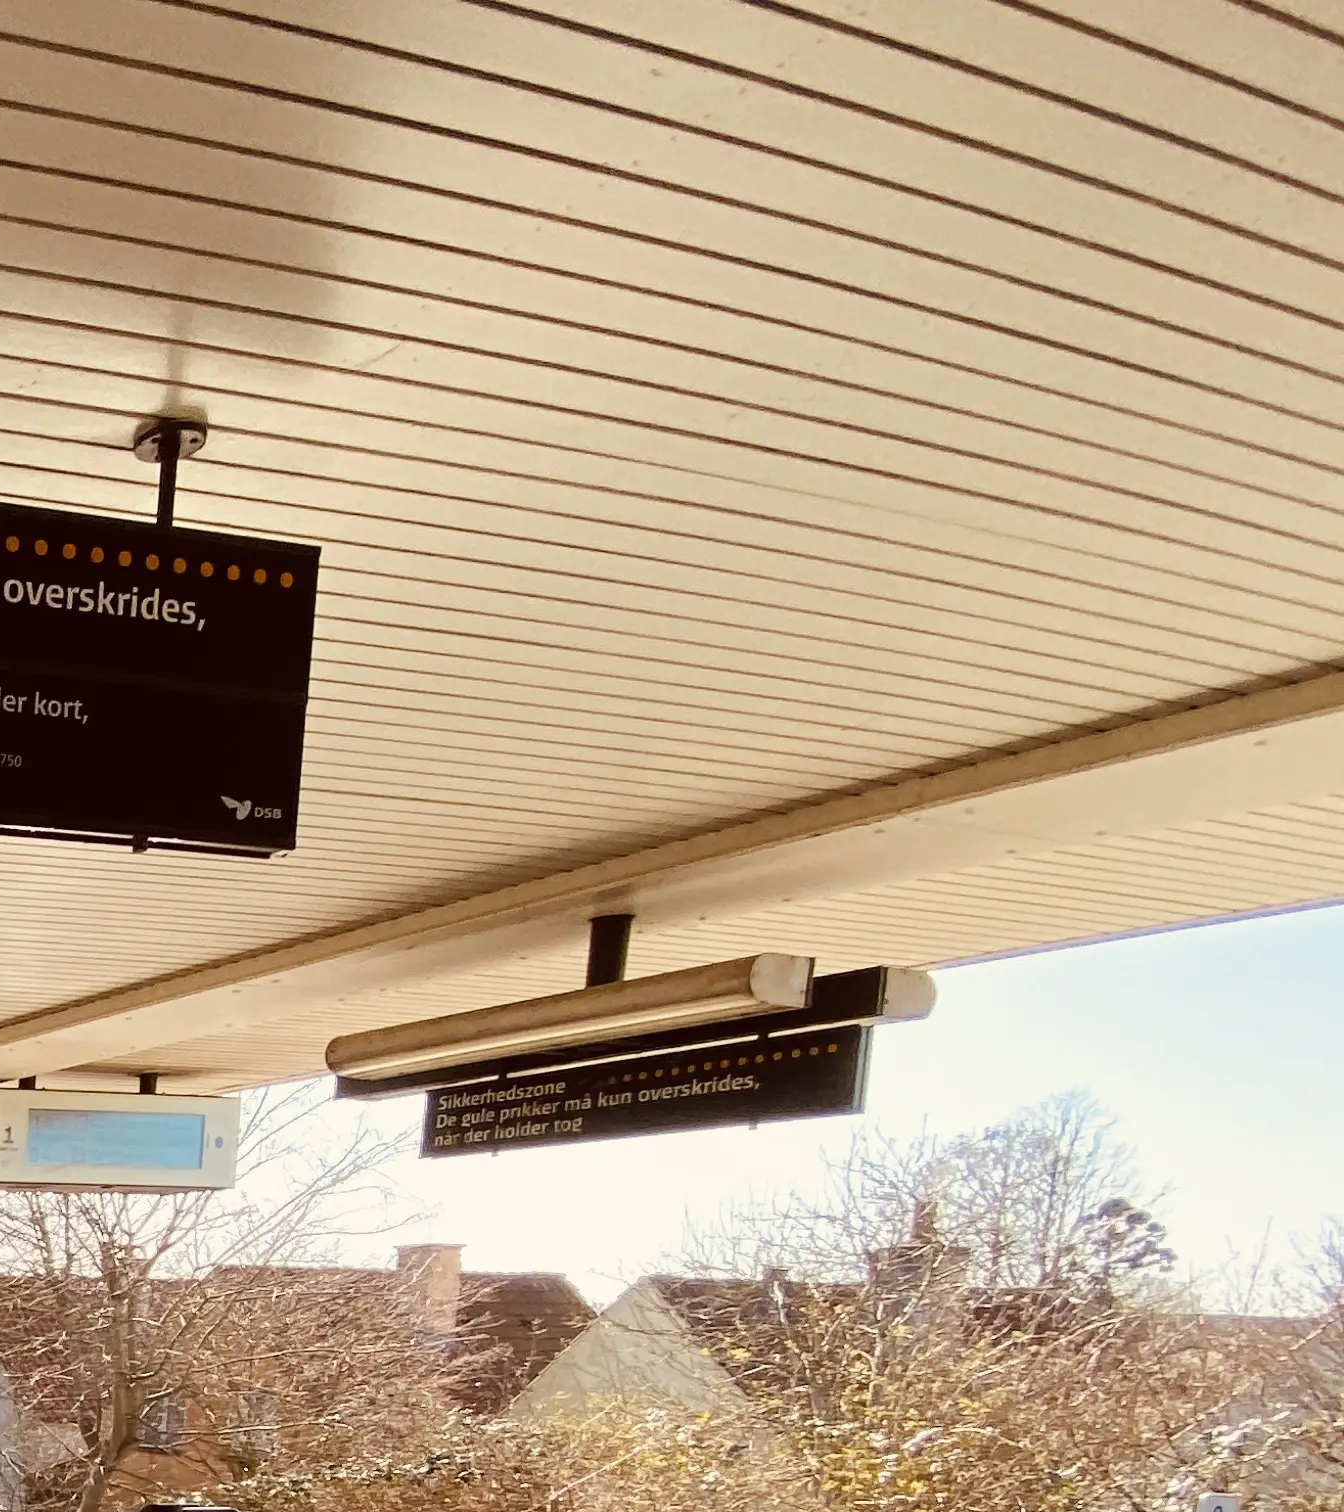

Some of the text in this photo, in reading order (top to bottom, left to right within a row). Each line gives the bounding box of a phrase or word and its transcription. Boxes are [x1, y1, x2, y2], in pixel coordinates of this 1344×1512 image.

[3, 579, 206, 632] overskrides,
[34, 692, 89, 725] kort,
[0, 753, 22, 768] 750
[254, 806, 282, 819] DSB
[436, 1113, 457, 1128] De
[461, 1106, 496, 1128] gule
[565, 1093, 592, 1112] må
[597, 1091, 632, 1108] kun
[638, 1074, 760, 1102] overskrides,
[438, 1081, 566, 1110] Sikkerhedszone
[4, 1126, 14, 1143] 1
[464, 1125, 490, 1143] der
